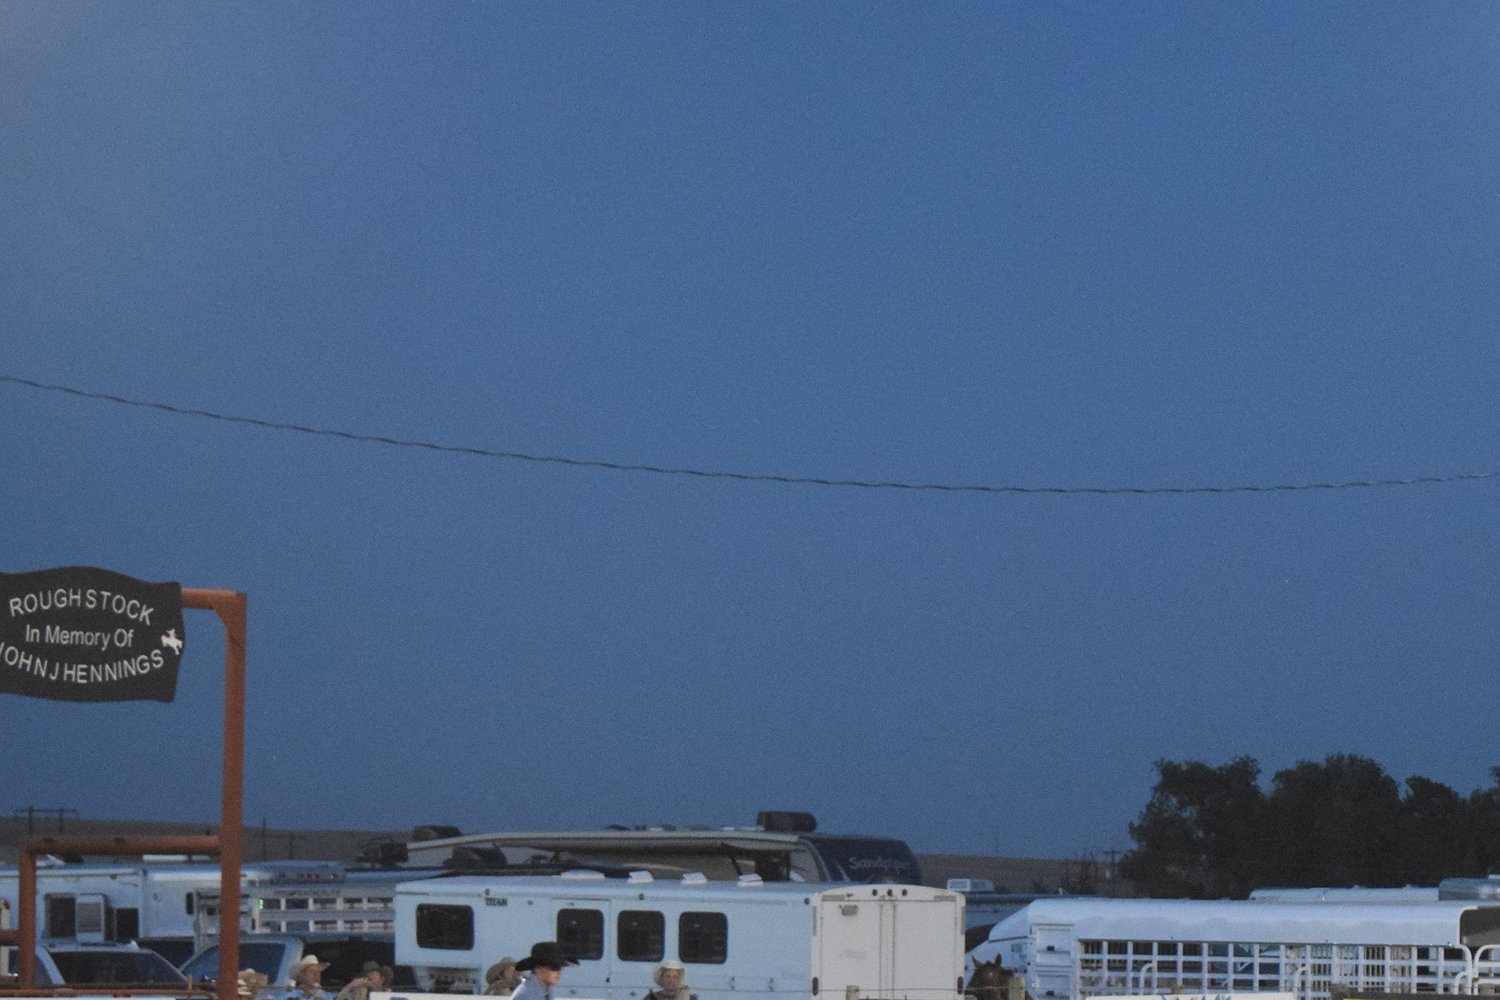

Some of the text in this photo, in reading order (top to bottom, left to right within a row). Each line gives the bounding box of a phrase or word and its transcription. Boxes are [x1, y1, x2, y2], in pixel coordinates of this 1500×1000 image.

[25, 624, 134, 651] In Memory Of
[0, 642, 164, 683] OHN J HENNINGS
